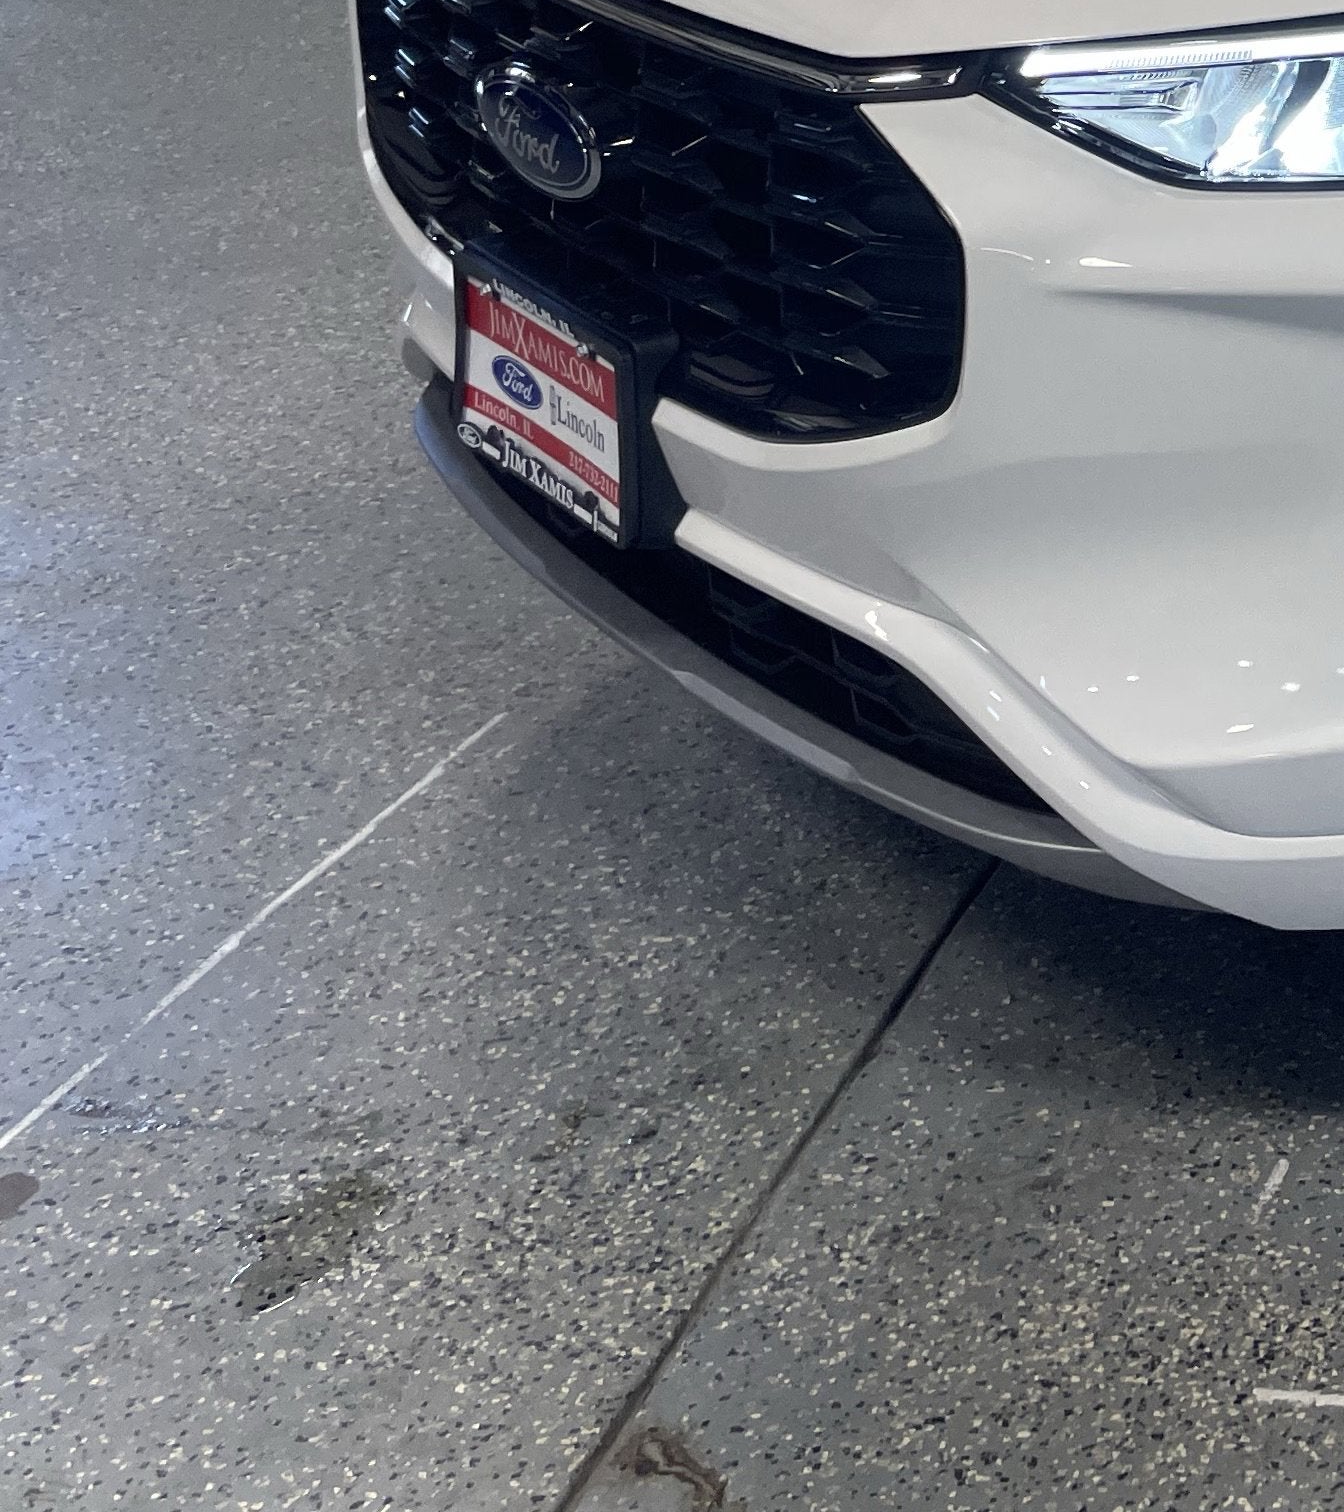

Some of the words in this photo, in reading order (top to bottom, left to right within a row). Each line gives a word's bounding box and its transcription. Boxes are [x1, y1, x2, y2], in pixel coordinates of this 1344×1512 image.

[494, 94, 560, 174] Ford
[501, 362, 533, 403] Ford
[556, 395, 606, 454] Lincoln
[502, 440, 527, 478] JIM
[529, 458, 574, 509] XAMIS
